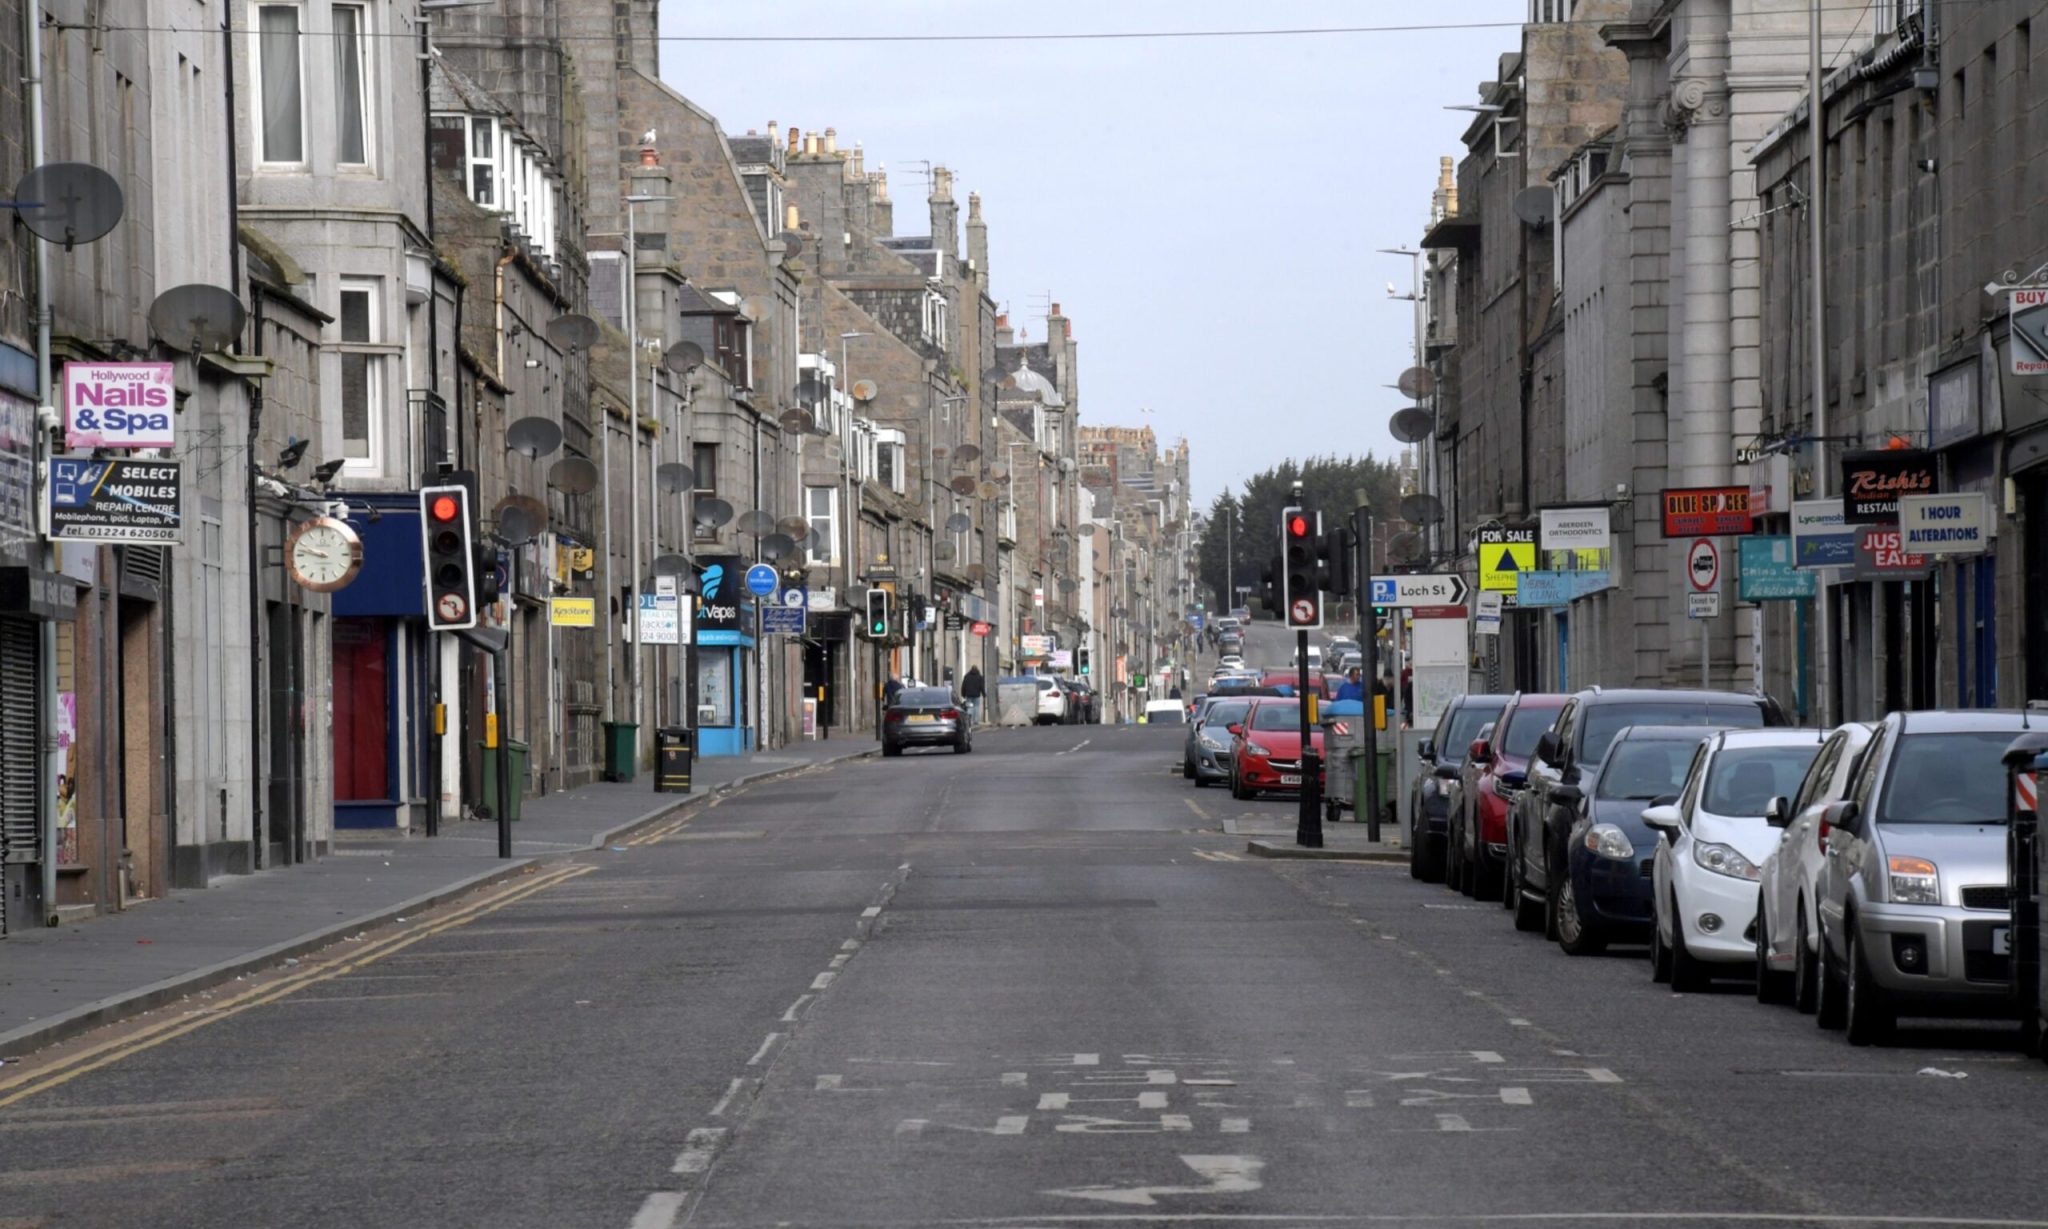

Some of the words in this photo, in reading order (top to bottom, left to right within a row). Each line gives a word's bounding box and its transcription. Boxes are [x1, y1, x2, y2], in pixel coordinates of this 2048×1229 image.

[2015, 291, 2047, 304] BUY
[91, 370, 150, 381] Hollywood
[75, 383, 168, 407] Nails
[75, 408, 100, 430] &
[103, 408, 169, 435] Spa
[121, 467, 178, 480] SELECT
[1850, 469, 1932, 494] Rishi's
[109, 485, 177, 499] MOBILES
[95, 502, 132, 513] REPAIR
[135, 503, 176, 514] CENTRE
[1669, 495, 1698, 514] BLUE
[54, 512, 108, 523] Mobilephone,
[163, 517, 175, 525] PC
[1798, 513, 1844, 525] Lycamob
[1920, 507, 1926, 520] 1
[1928, 506, 1962, 520] HOUR
[66, 528, 84, 536] tel.
[88, 528, 126, 537] 01224
[129, 529, 175, 539] 620506
[1481, 530, 1503, 543] FOR
[1506, 530, 1534, 542] SALE
[1549, 528, 1603, 537] ORTHODONTICS
[1909, 526, 1979, 542] ALTERATIONS
[1863, 533, 1902, 550] JUS
[1372, 582, 1388, 601] P
[1401, 585, 1430, 596] Loch
[1433, 584, 1447, 595] St
